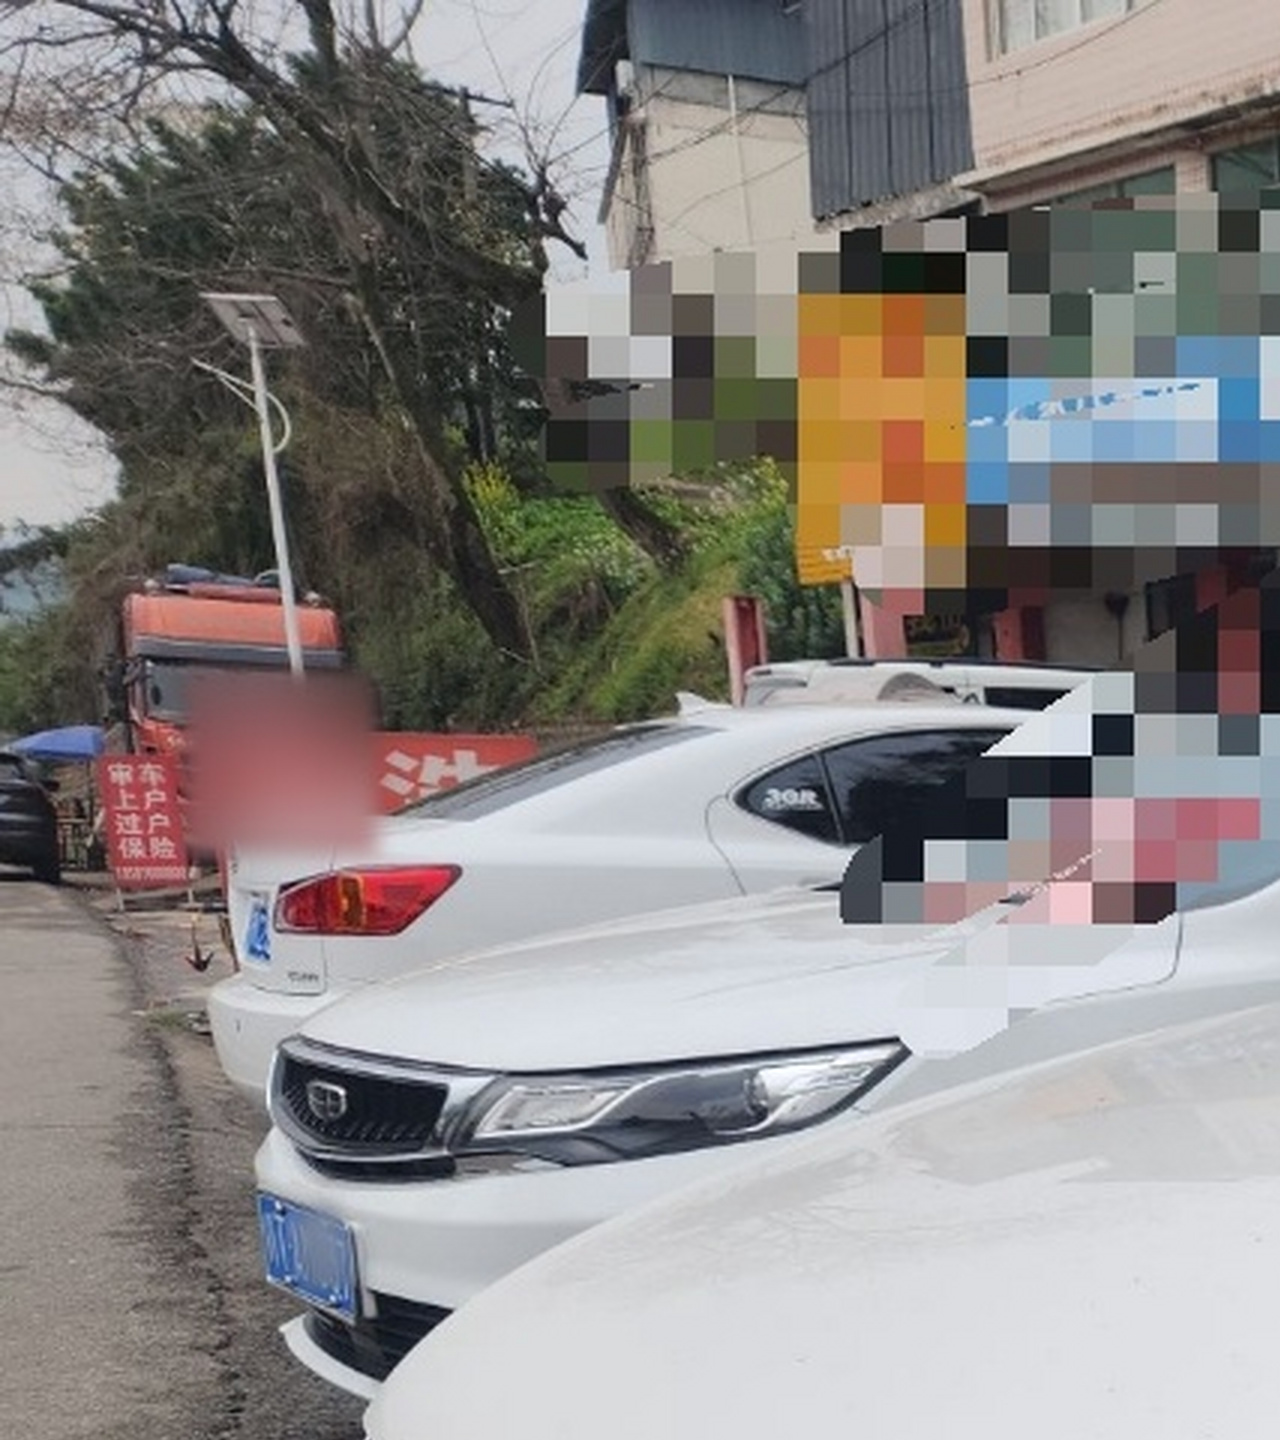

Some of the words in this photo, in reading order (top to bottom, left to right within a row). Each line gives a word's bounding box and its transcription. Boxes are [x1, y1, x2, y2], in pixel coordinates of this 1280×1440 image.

[114, 788, 166, 811] 上户
[116, 812, 170, 834] 过户
[119, 837, 177, 859] 保险
